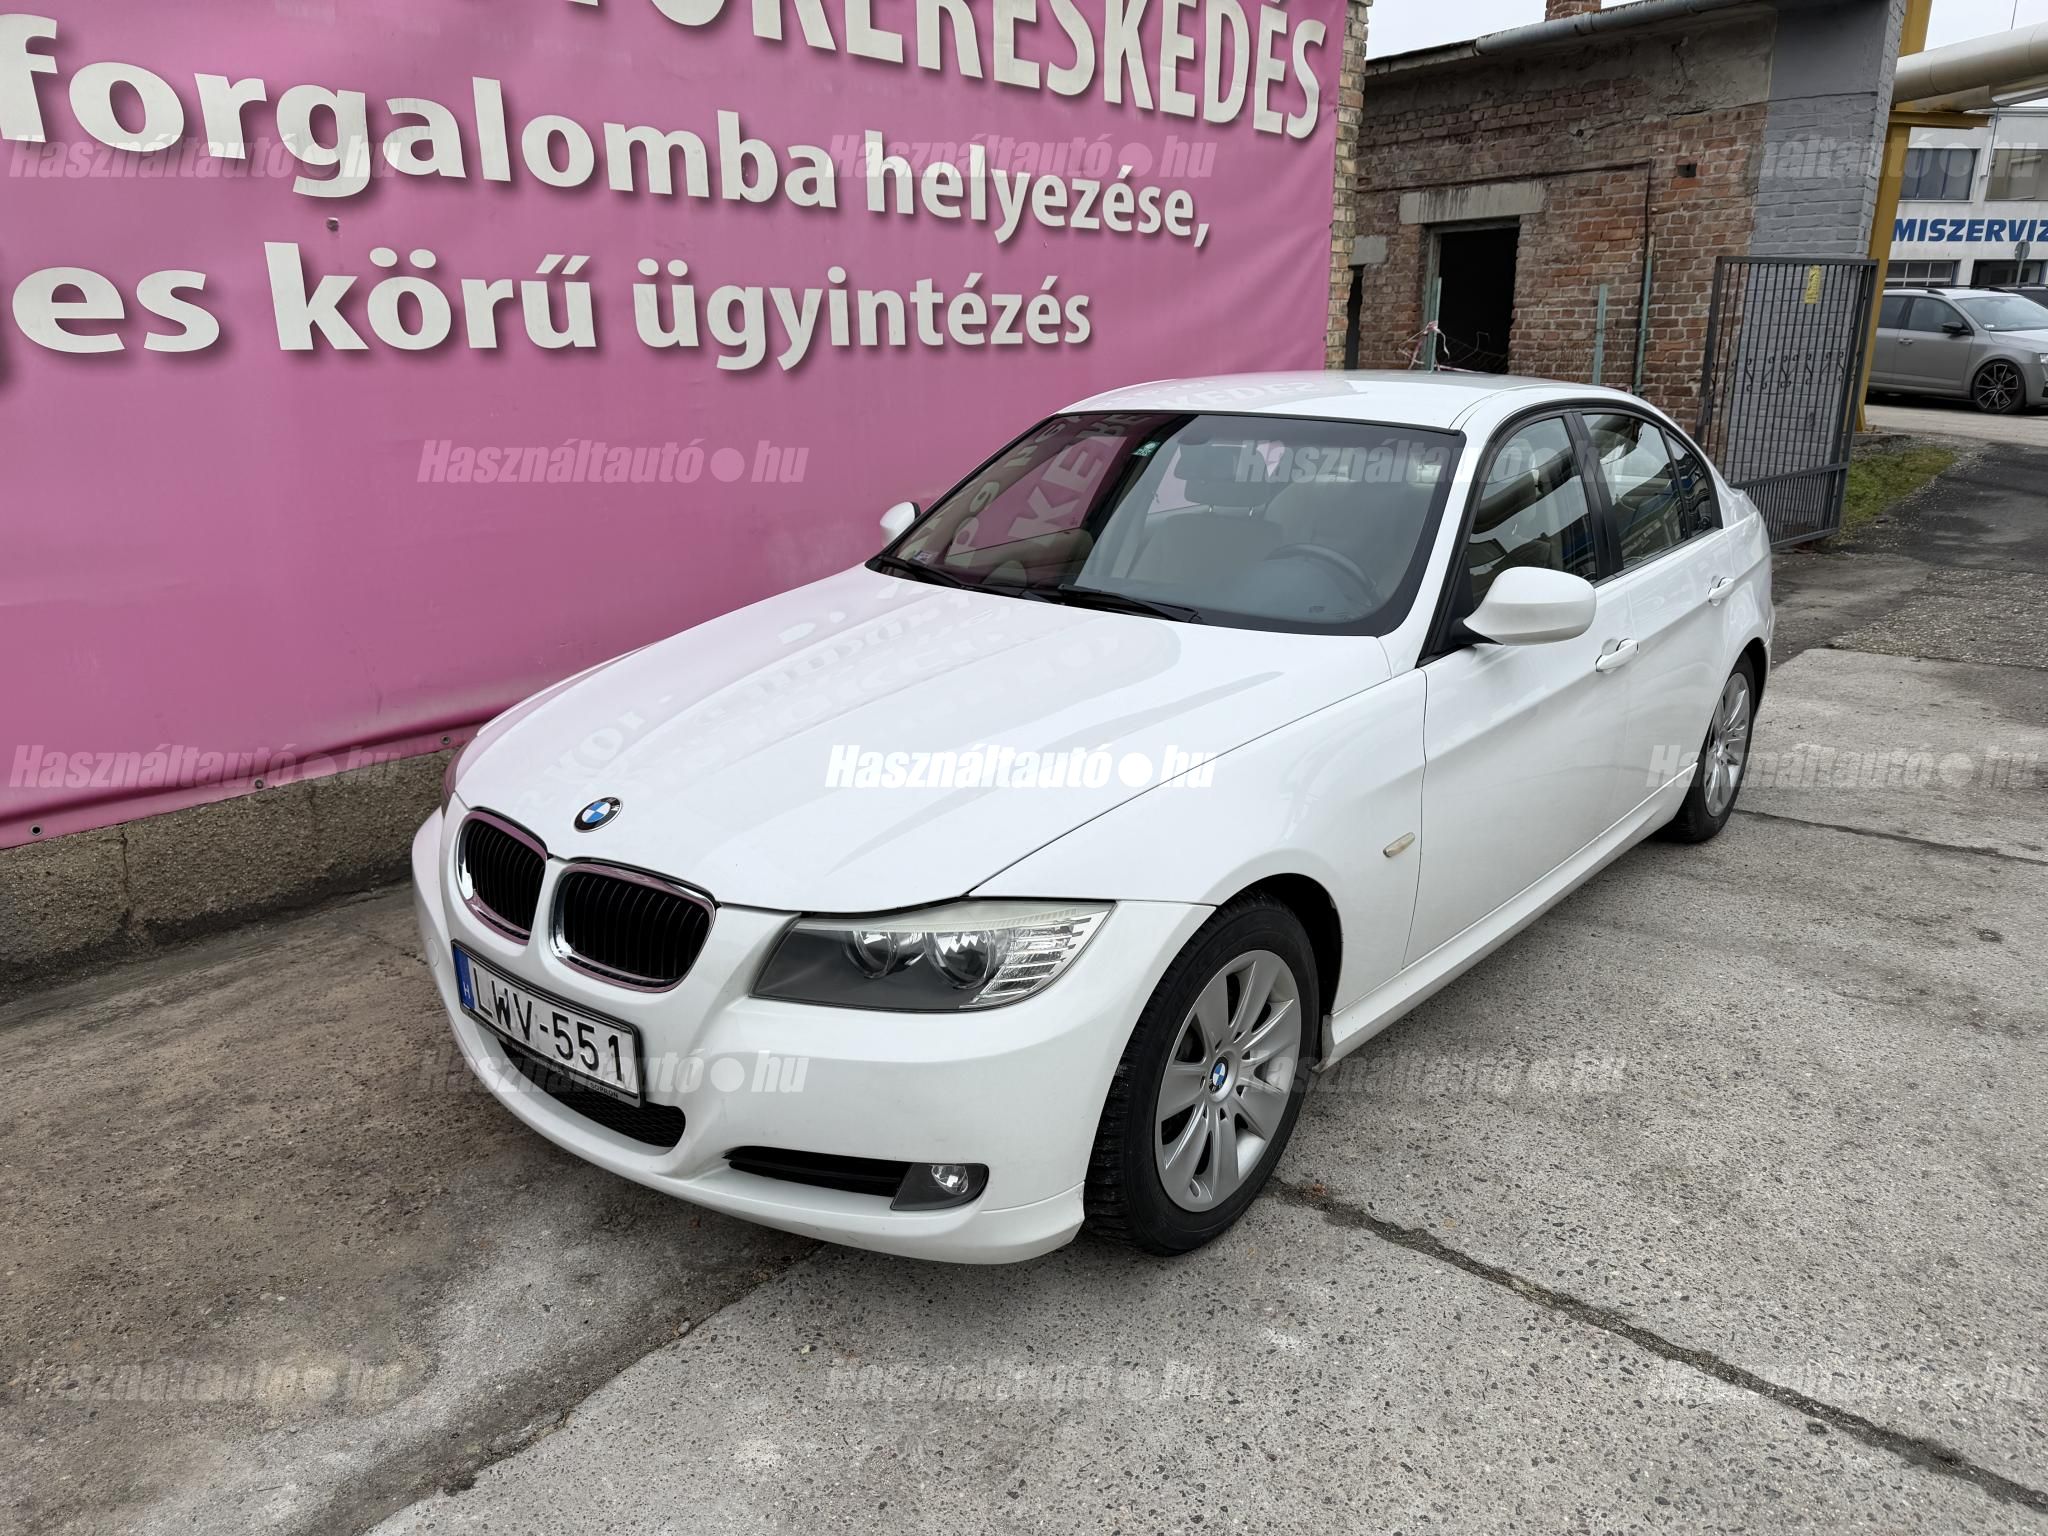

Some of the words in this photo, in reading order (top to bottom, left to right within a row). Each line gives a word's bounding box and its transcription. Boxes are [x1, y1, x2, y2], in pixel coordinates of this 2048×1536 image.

[0, 13, 837, 209] forgalomba
[864, 128, 1210, 248] helyezése,
[567, 0, 1327, 139] ESKEDÉS
[12, 266, 220, 354] es
[264, 242, 597, 351] körű
[632, 258, 1091, 372] ügyintézés
[473, 967, 623, 1082] LWV-551
